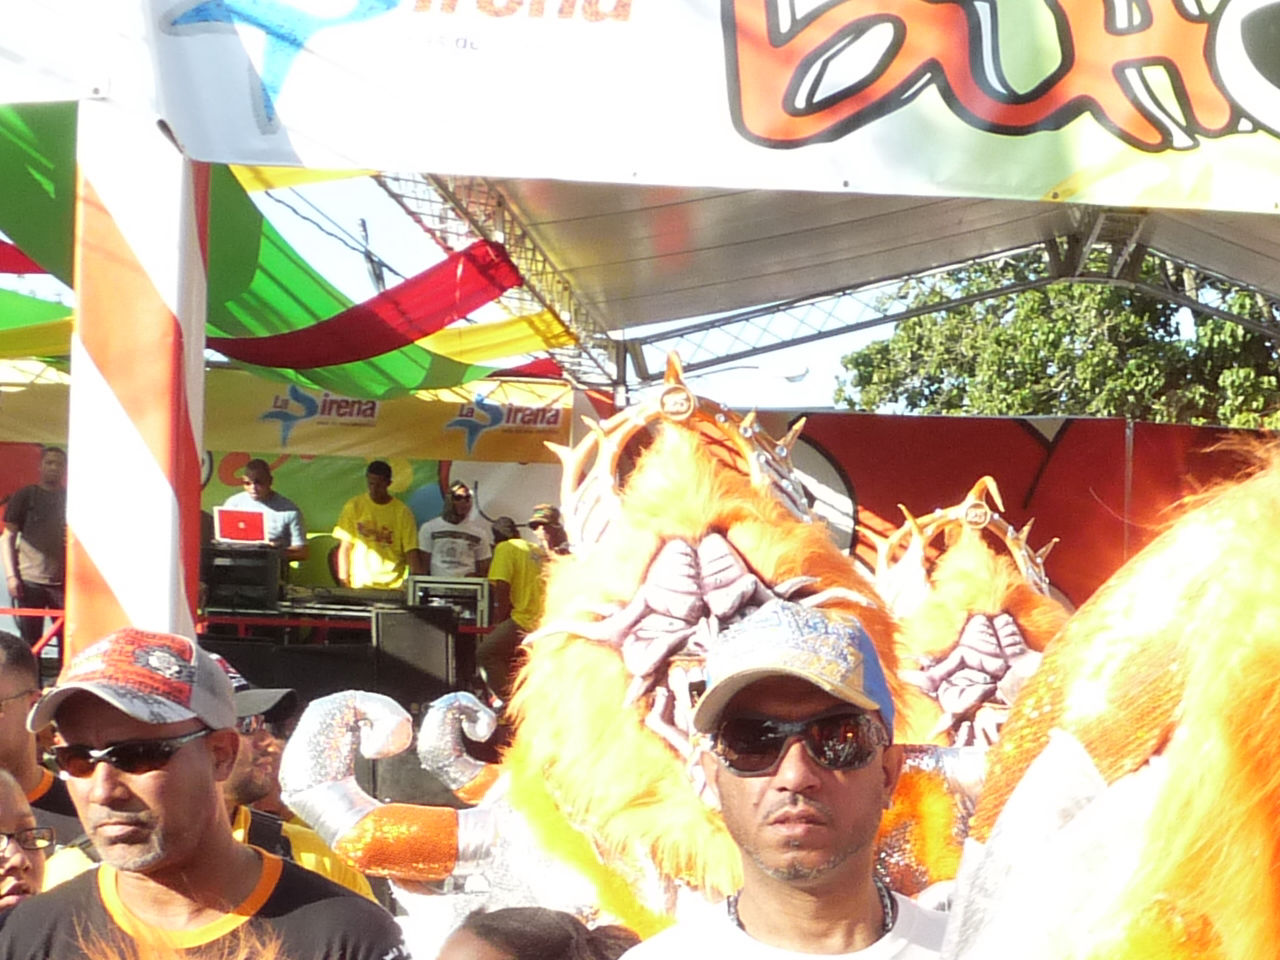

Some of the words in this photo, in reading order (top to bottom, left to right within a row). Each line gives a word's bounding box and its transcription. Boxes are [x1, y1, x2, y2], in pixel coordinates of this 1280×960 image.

[259, 384, 377, 421] Sirena
[446, 393, 560, 428] Sirena
[458, 404, 475, 418] La
